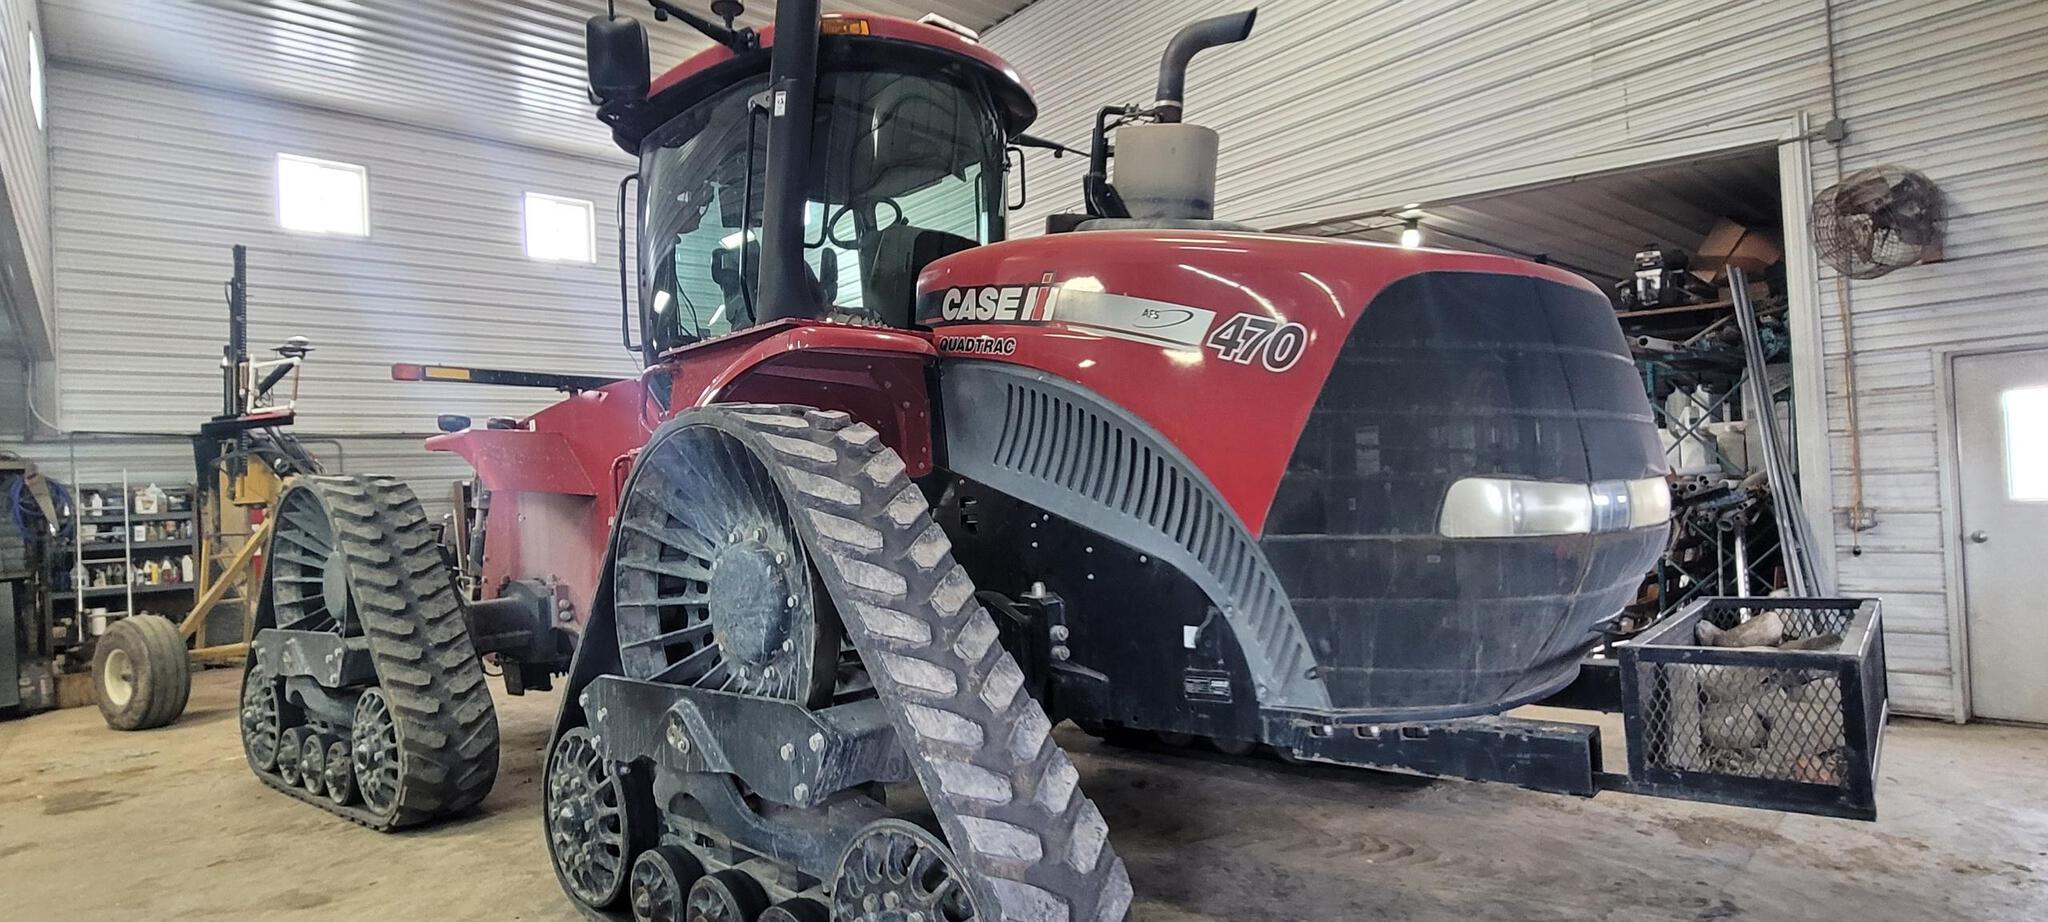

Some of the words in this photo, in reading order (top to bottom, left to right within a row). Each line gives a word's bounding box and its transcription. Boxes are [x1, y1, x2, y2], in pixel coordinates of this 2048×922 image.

[942, 287, 1023, 321] CASE
[1142, 308, 1160, 320] AFS
[939, 336, 1017, 356] QUADTRAC
[1206, 312, 1308, 373] 470
